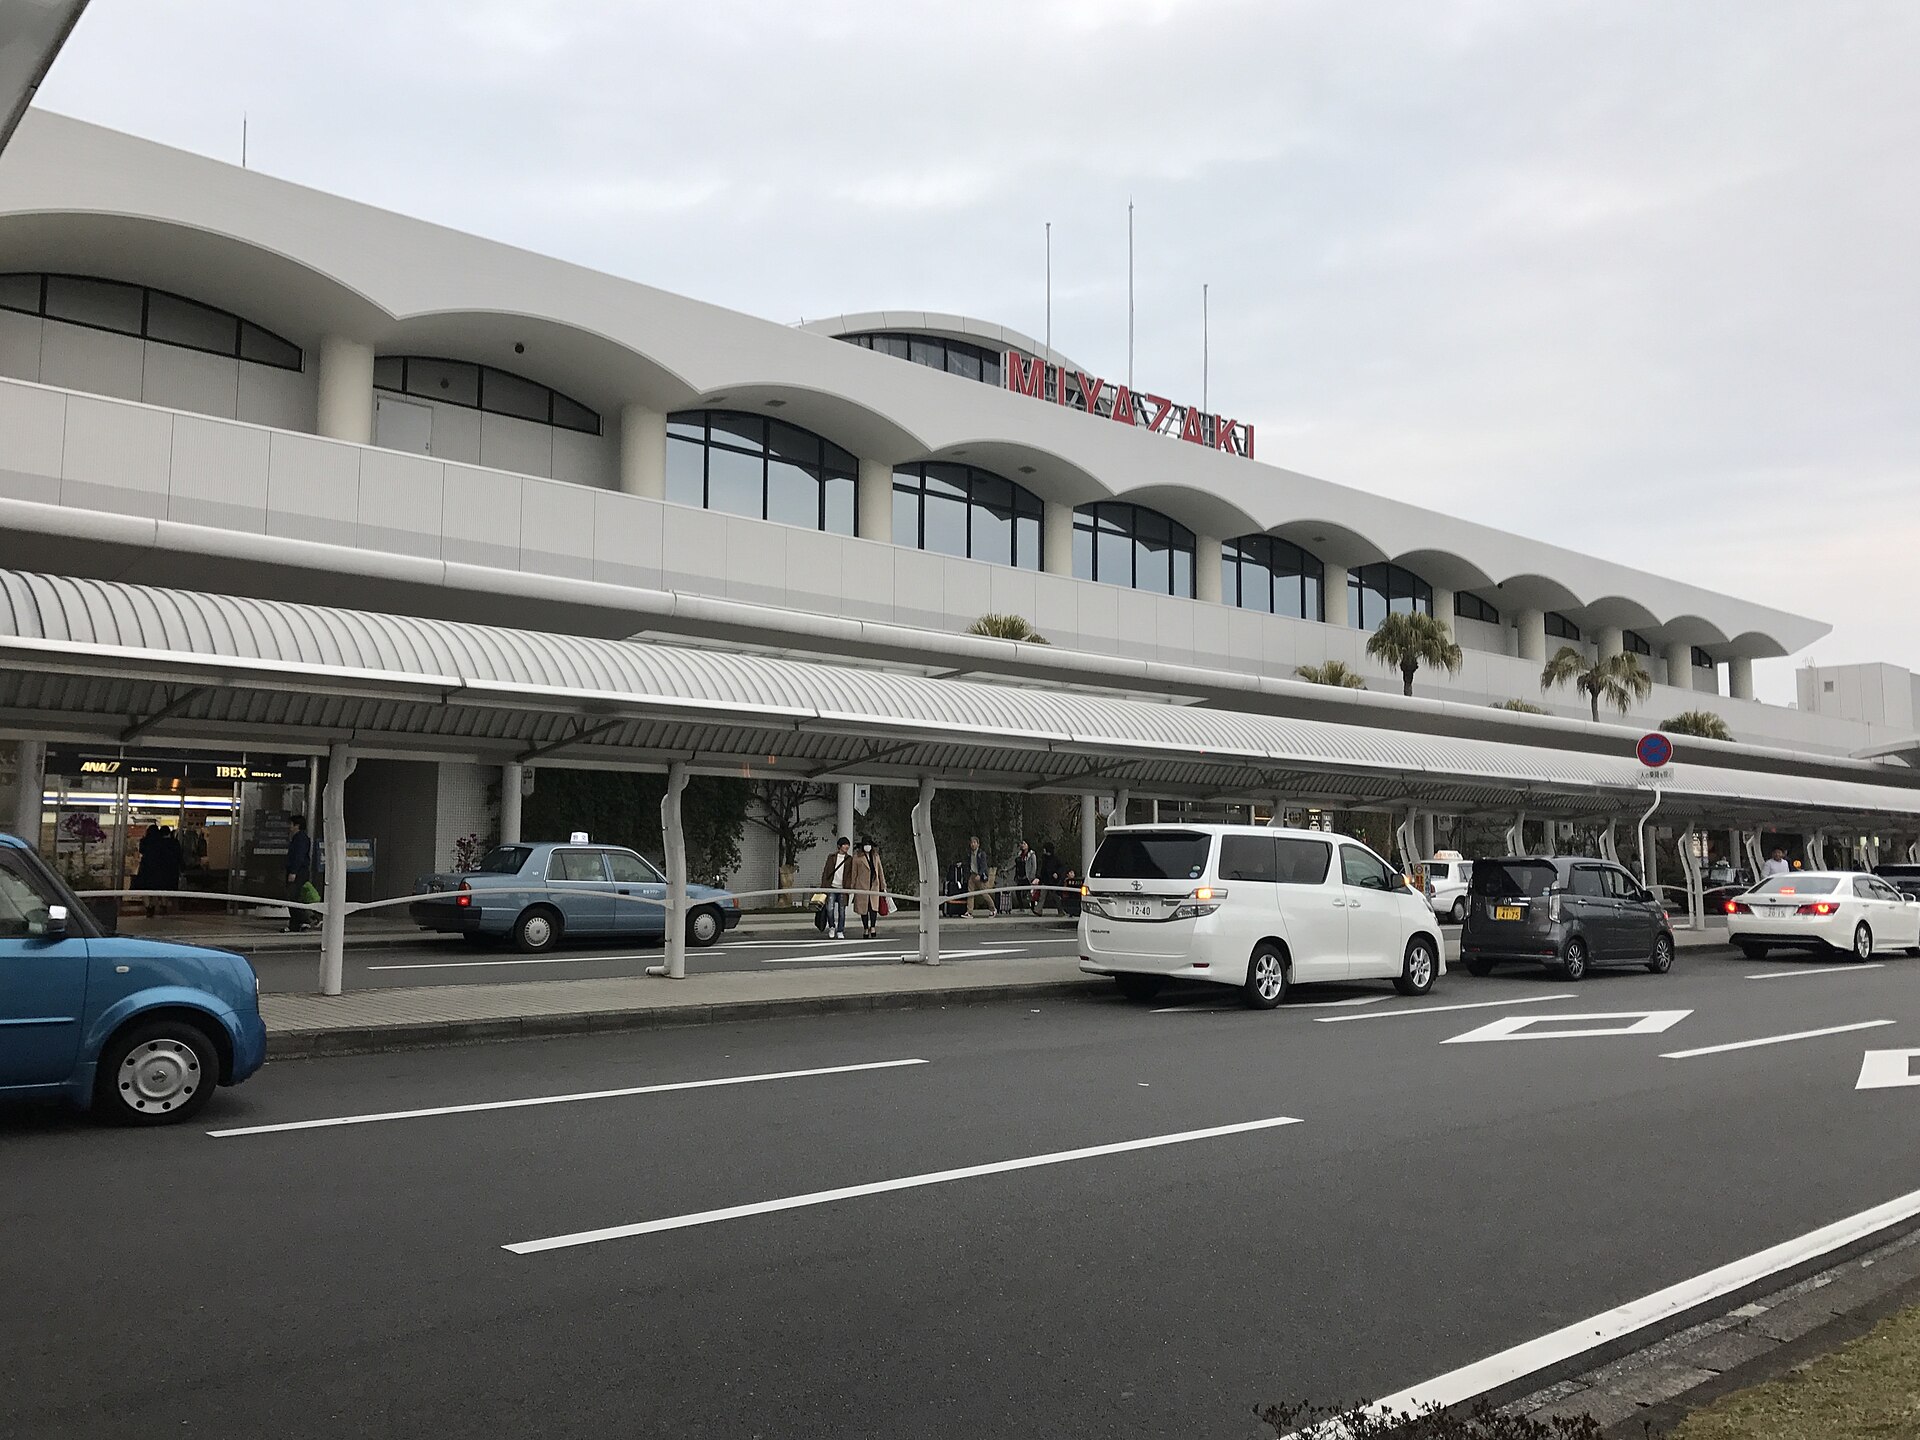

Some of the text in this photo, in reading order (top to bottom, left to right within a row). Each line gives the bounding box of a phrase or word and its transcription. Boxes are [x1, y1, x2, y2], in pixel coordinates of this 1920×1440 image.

[1007, 351, 1254, 459] MIYAZAKI
[81, 762, 107, 772] ANA
[216, 766, 247, 778] IBEX
